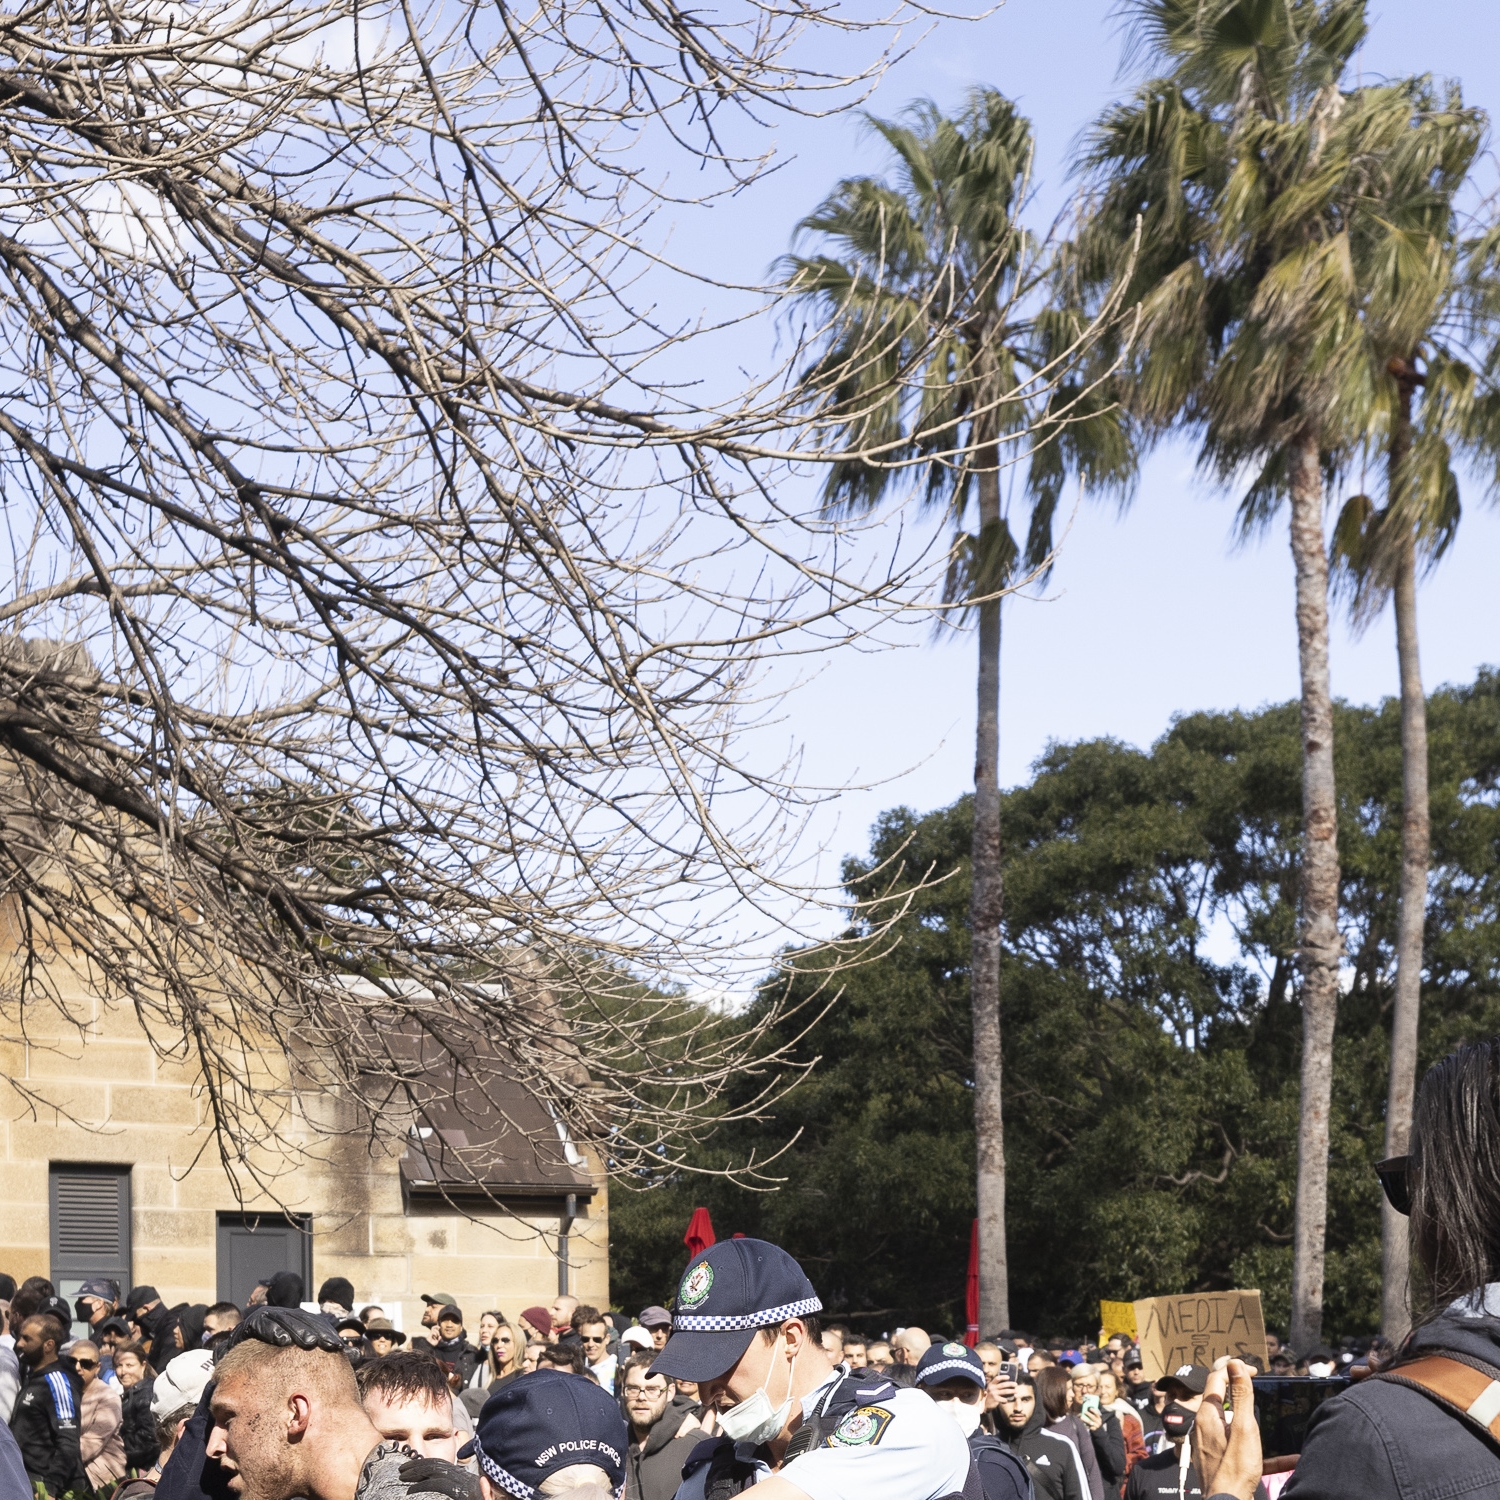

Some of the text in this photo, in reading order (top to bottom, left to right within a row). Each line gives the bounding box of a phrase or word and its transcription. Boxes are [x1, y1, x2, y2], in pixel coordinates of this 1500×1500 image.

[1144, 1298, 1250, 1339] MEDIA
[535, 1440, 621, 1468] NSW POLICE FORCE
